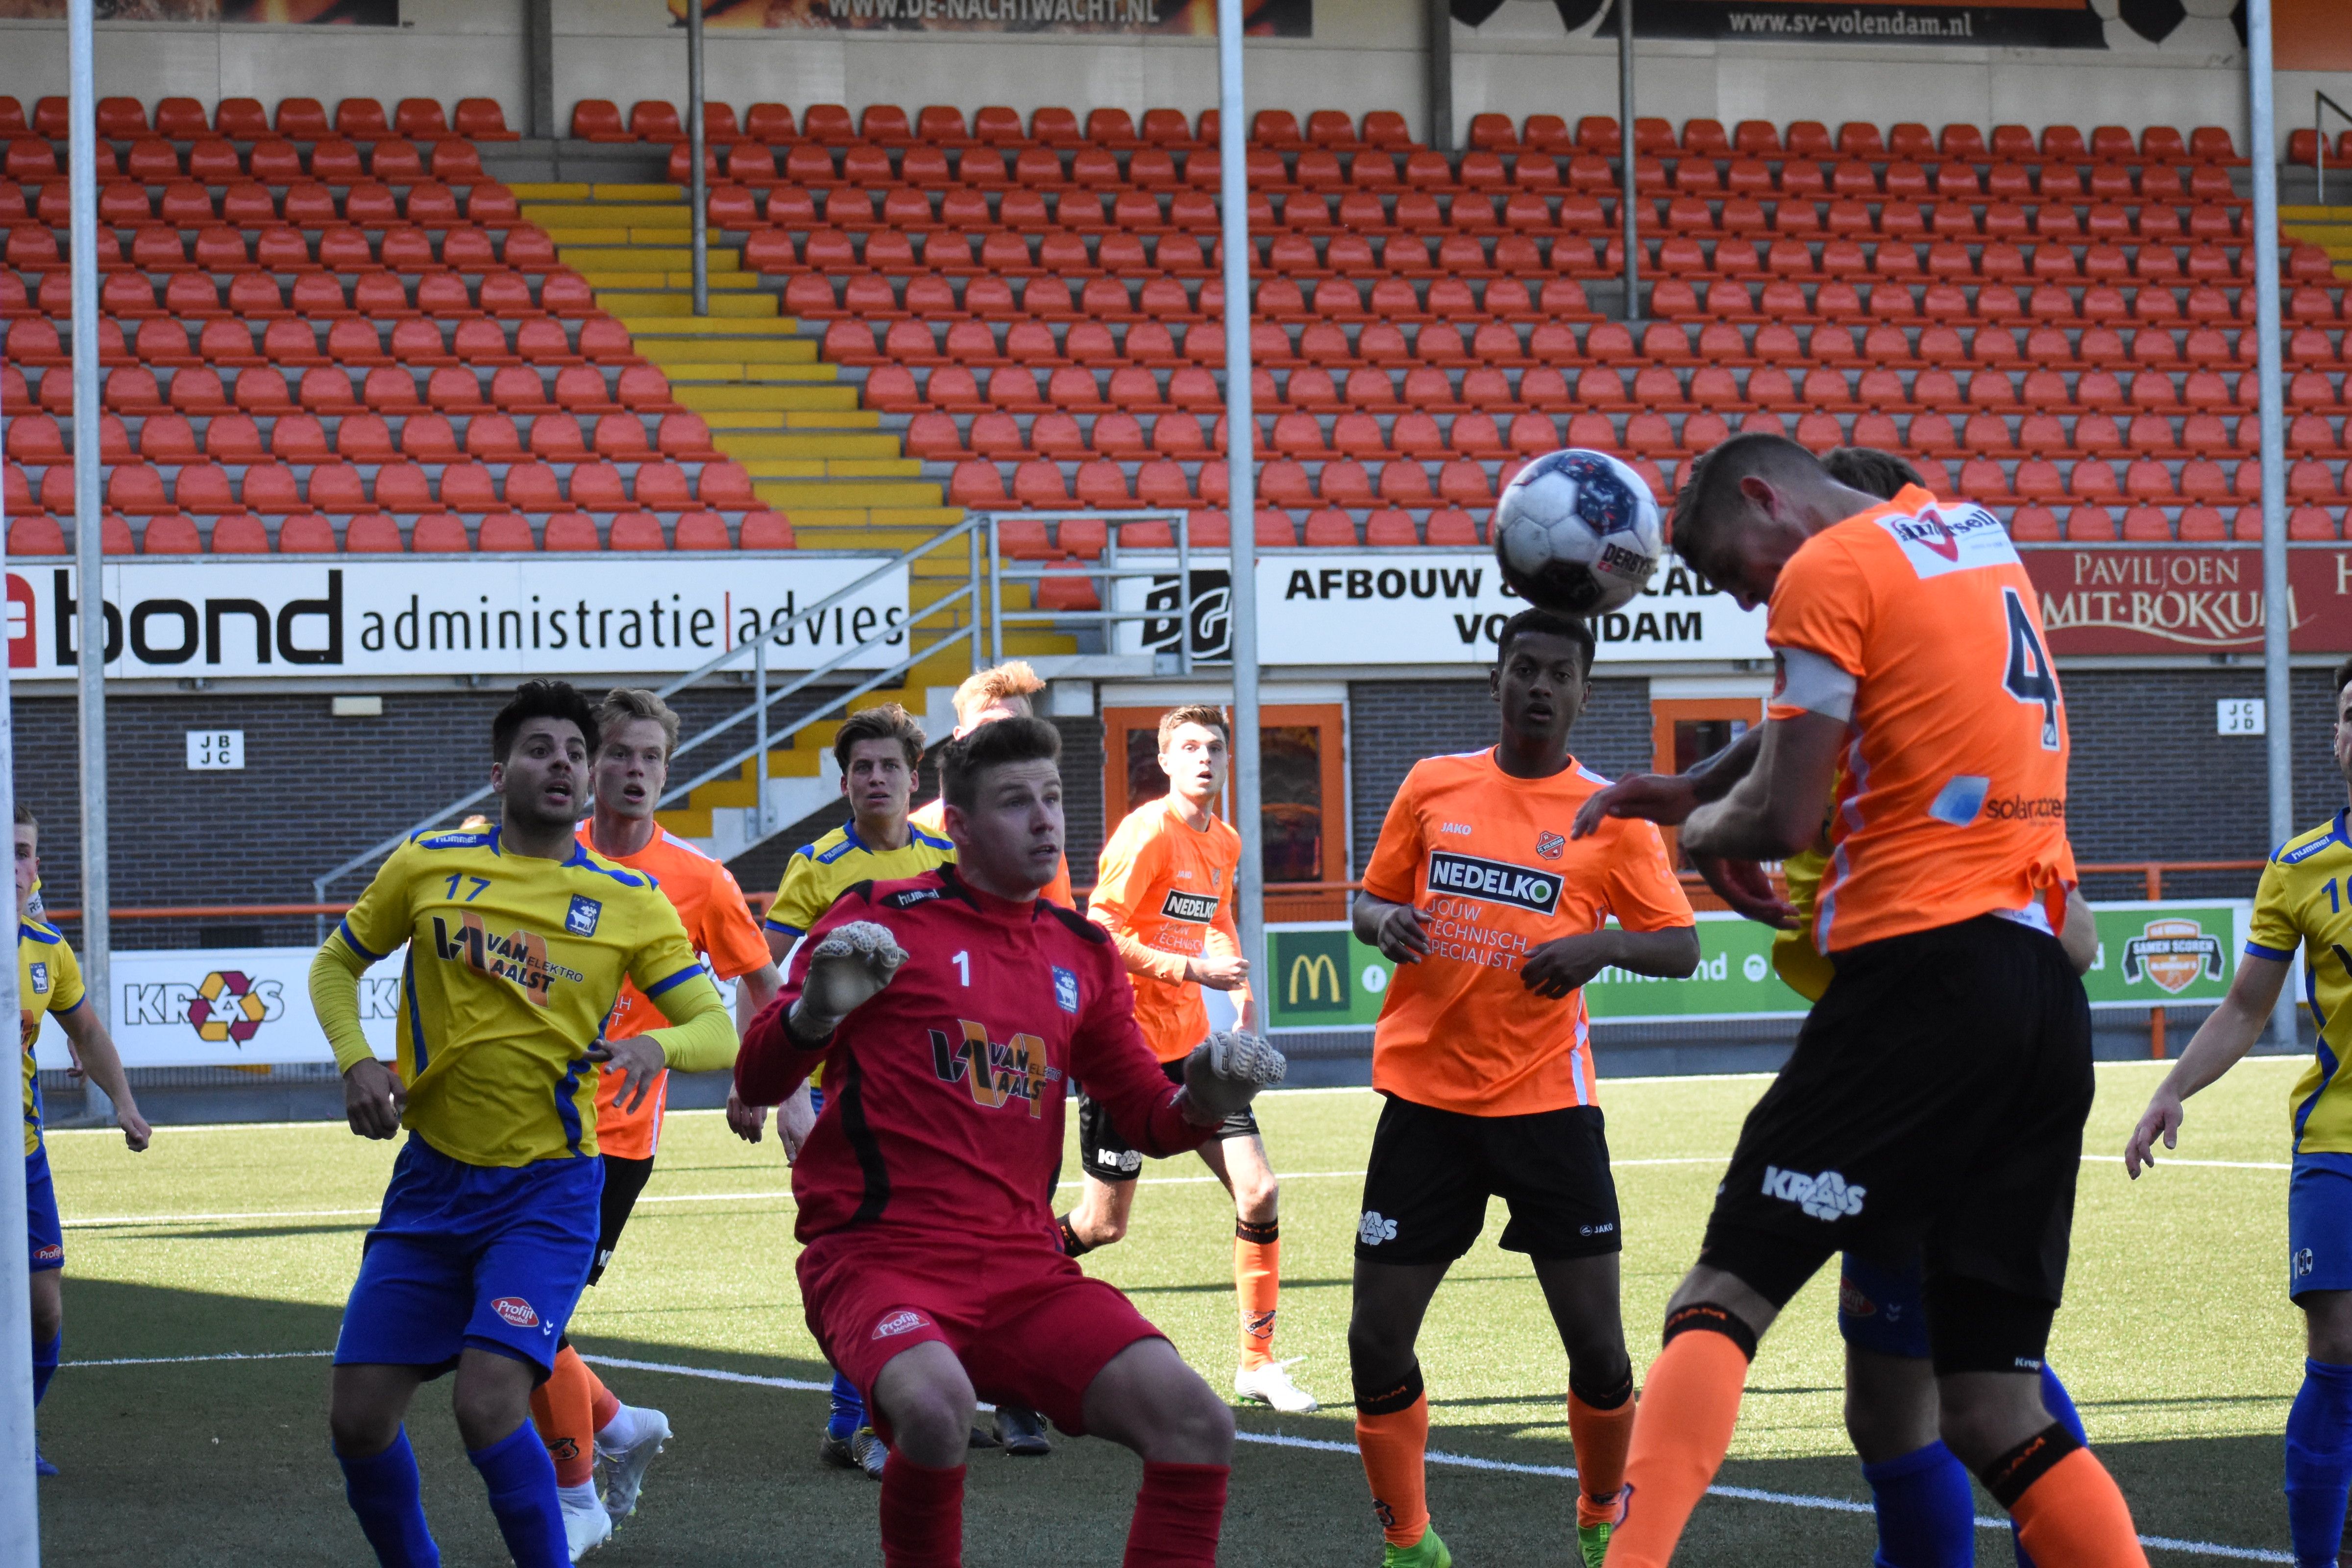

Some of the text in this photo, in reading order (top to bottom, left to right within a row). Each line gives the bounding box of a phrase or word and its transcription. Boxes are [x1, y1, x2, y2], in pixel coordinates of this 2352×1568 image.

[1728, 9, 1973, 36] www.sv-volendam.nl
[1285, 569, 1483, 600] AFBOUW
[2074, 552, 2240, 588] PAVILJOEN
[361, 590, 904, 651] administratie advies
[2001, 586, 2060, 752] 4
[436, 834, 476, 844] hummel
[1441, 822, 1472, 835] JAKO
[1543, 837, 1564, 851] VOLENDAM
[2291, 836, 2329, 860] hummel
[445, 872, 491, 902] 17
[1433, 860, 1552, 904] NEDELKO
[1426, 898, 1482, 921] JOUW
[487, 932, 529, 963] VAN
[1431, 939, 1517, 972] PECIALIST.
[490, 959, 556, 994] AALST
[527, 956, 584, 983] ELEKTRO
[952, 950, 970, 987] 1
[990, 1042, 1029, 1072] VAN
[1761, 1165, 1867, 1218] KRAS
[1594, 1223, 1614, 1234] JAKO
[497, 1300, 534, 1320] Profijt
[504, 1313, 528, 1324] Meubel
